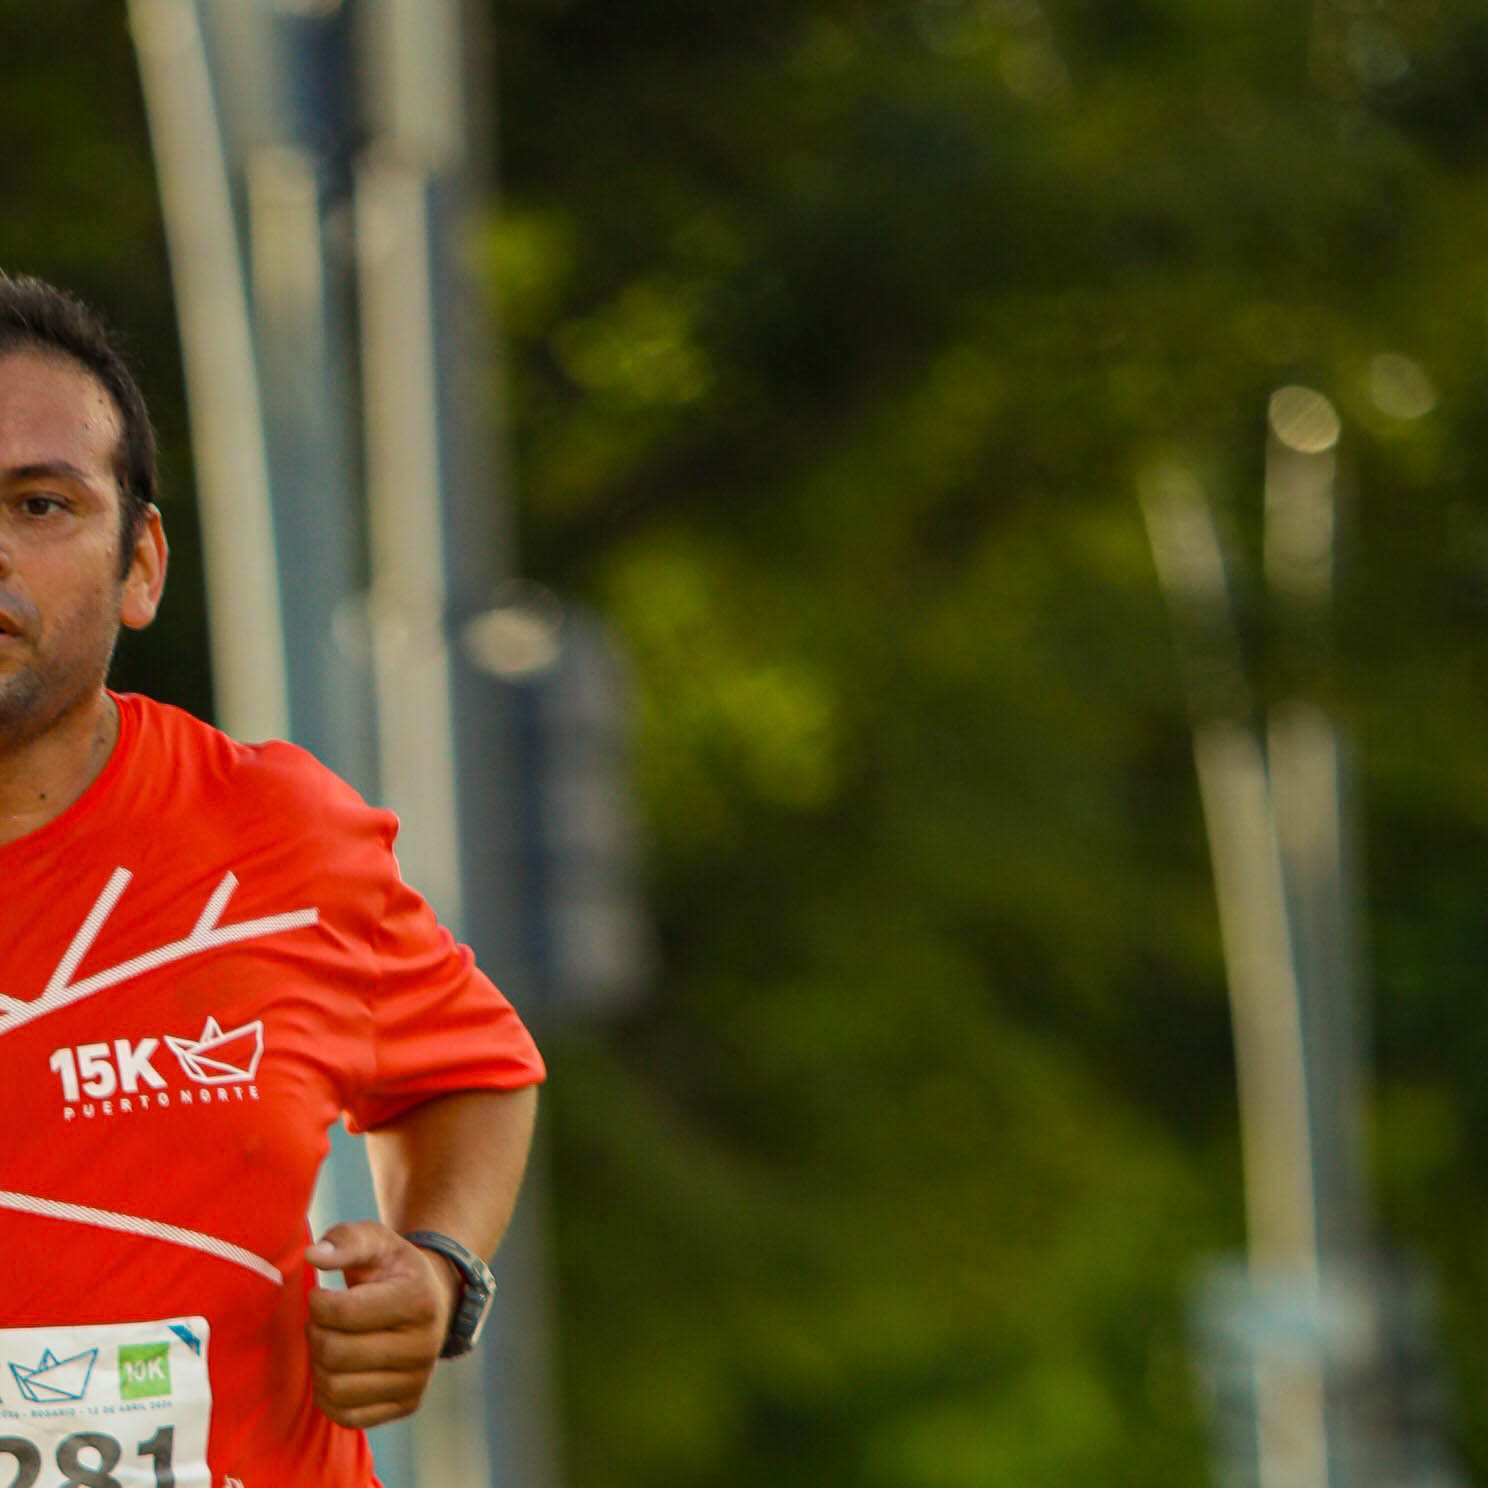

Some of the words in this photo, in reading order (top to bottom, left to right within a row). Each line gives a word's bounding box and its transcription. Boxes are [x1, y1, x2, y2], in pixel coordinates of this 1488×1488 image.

[49, 1037, 168, 1103] 15K
[63, 1091, 171, 1122] PUERTO
[179, 1085, 260, 1105] NORTE
